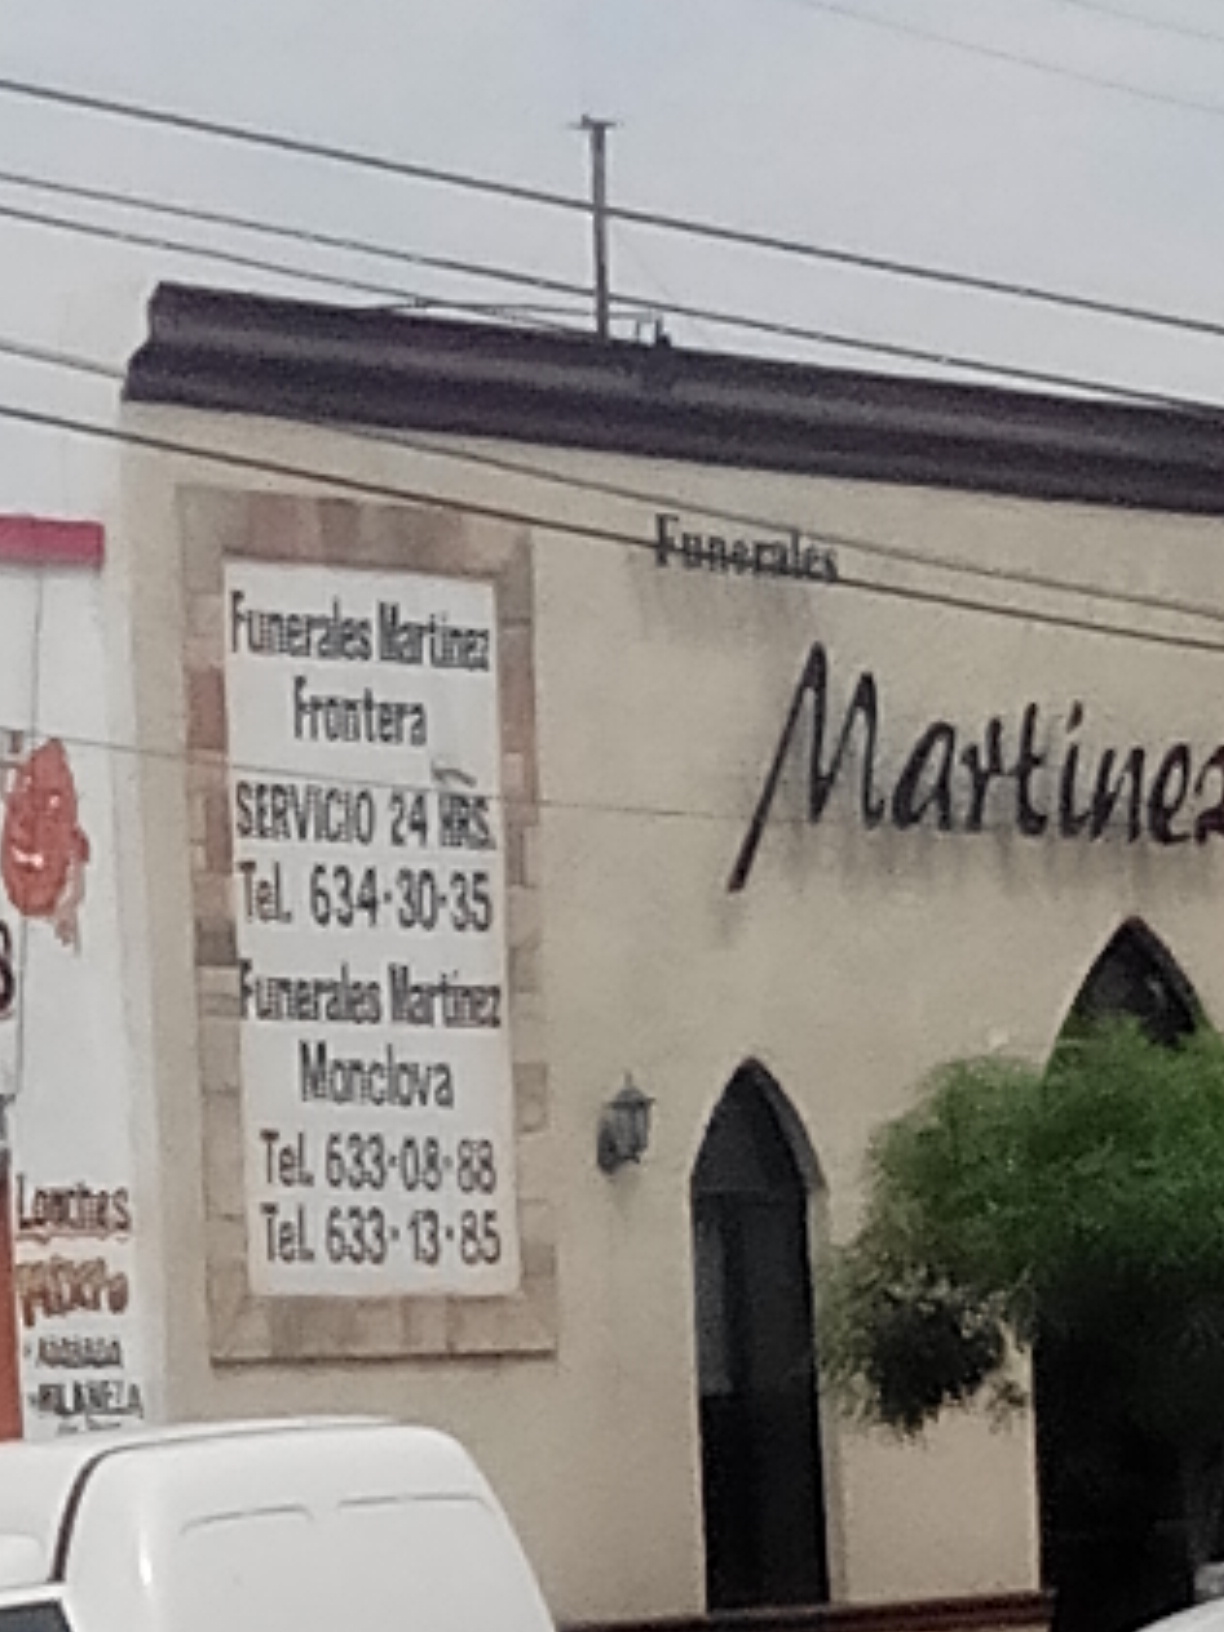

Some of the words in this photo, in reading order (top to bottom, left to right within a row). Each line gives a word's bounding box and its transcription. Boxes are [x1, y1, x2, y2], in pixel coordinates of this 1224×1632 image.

[655, 513, 839, 582] Funerales
[231, 590, 373, 661] Funerales
[294, 675, 428, 746] Frontera
[235, 781, 375, 844] SERVICIO
[389, 793, 428, 848] 24
[240, 958, 381, 1024] Funerales
[299, 1040, 454, 1109] Monclova
